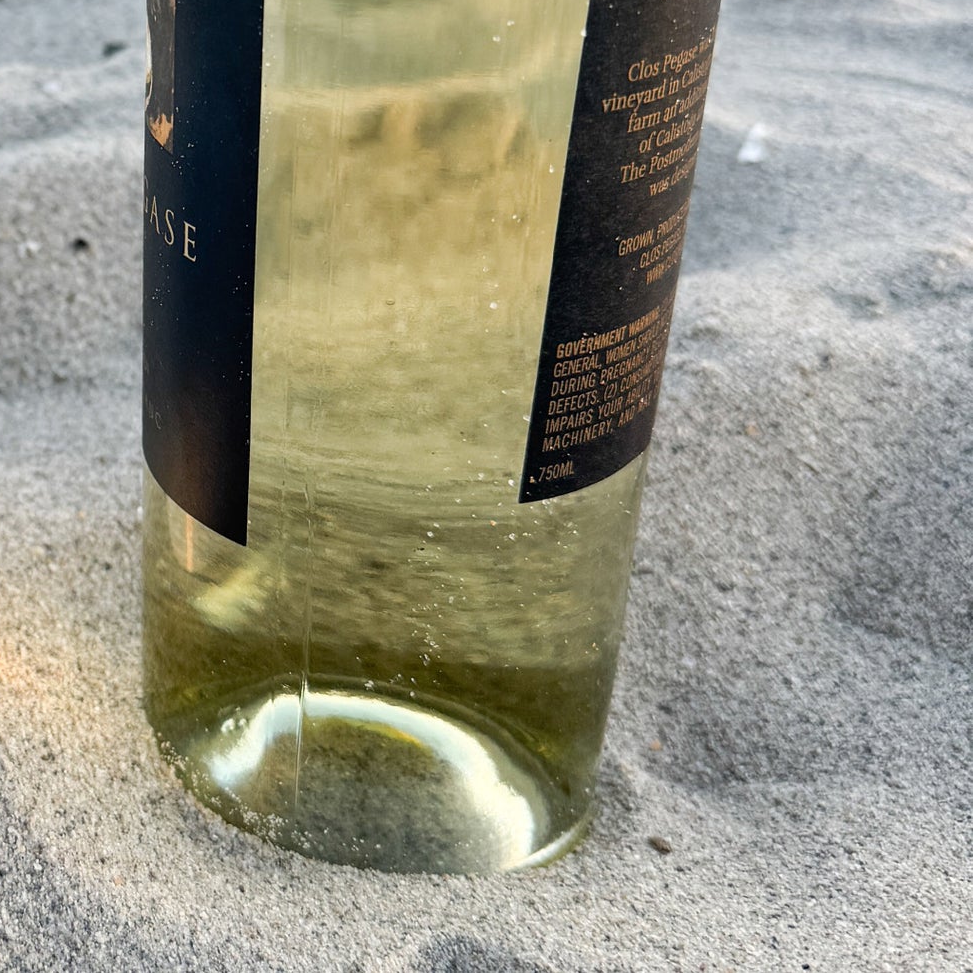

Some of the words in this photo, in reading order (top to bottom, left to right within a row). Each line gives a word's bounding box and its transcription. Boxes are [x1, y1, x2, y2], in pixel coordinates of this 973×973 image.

[628, 59, 659, 82] Clos
[661, 46, 698, 73] Pegase
[602, 78, 666, 114] vineyard
[669, 77, 680, 95] in
[627, 111, 661, 133] farm
[639, 131, 655, 154] of
[621, 162, 646, 184] The
[649, 176, 670, 196] was
[640, 244, 661, 269] CLOS
[556, 326, 627, 359] GOVERNMENT
[606, 337, 637, 364] WOMEN
[551, 372, 596, 397] DURING
[548, 390, 599, 415] DEFECTS.
[604, 382, 617, 401] (2)
[545, 409, 594, 434] IMPAIRS
[598, 396, 624, 420] YOUR
[542, 418, 614, 453] MACHINERY,
[617, 405, 635, 428] AND
[538, 460, 575, 482] 750ML
